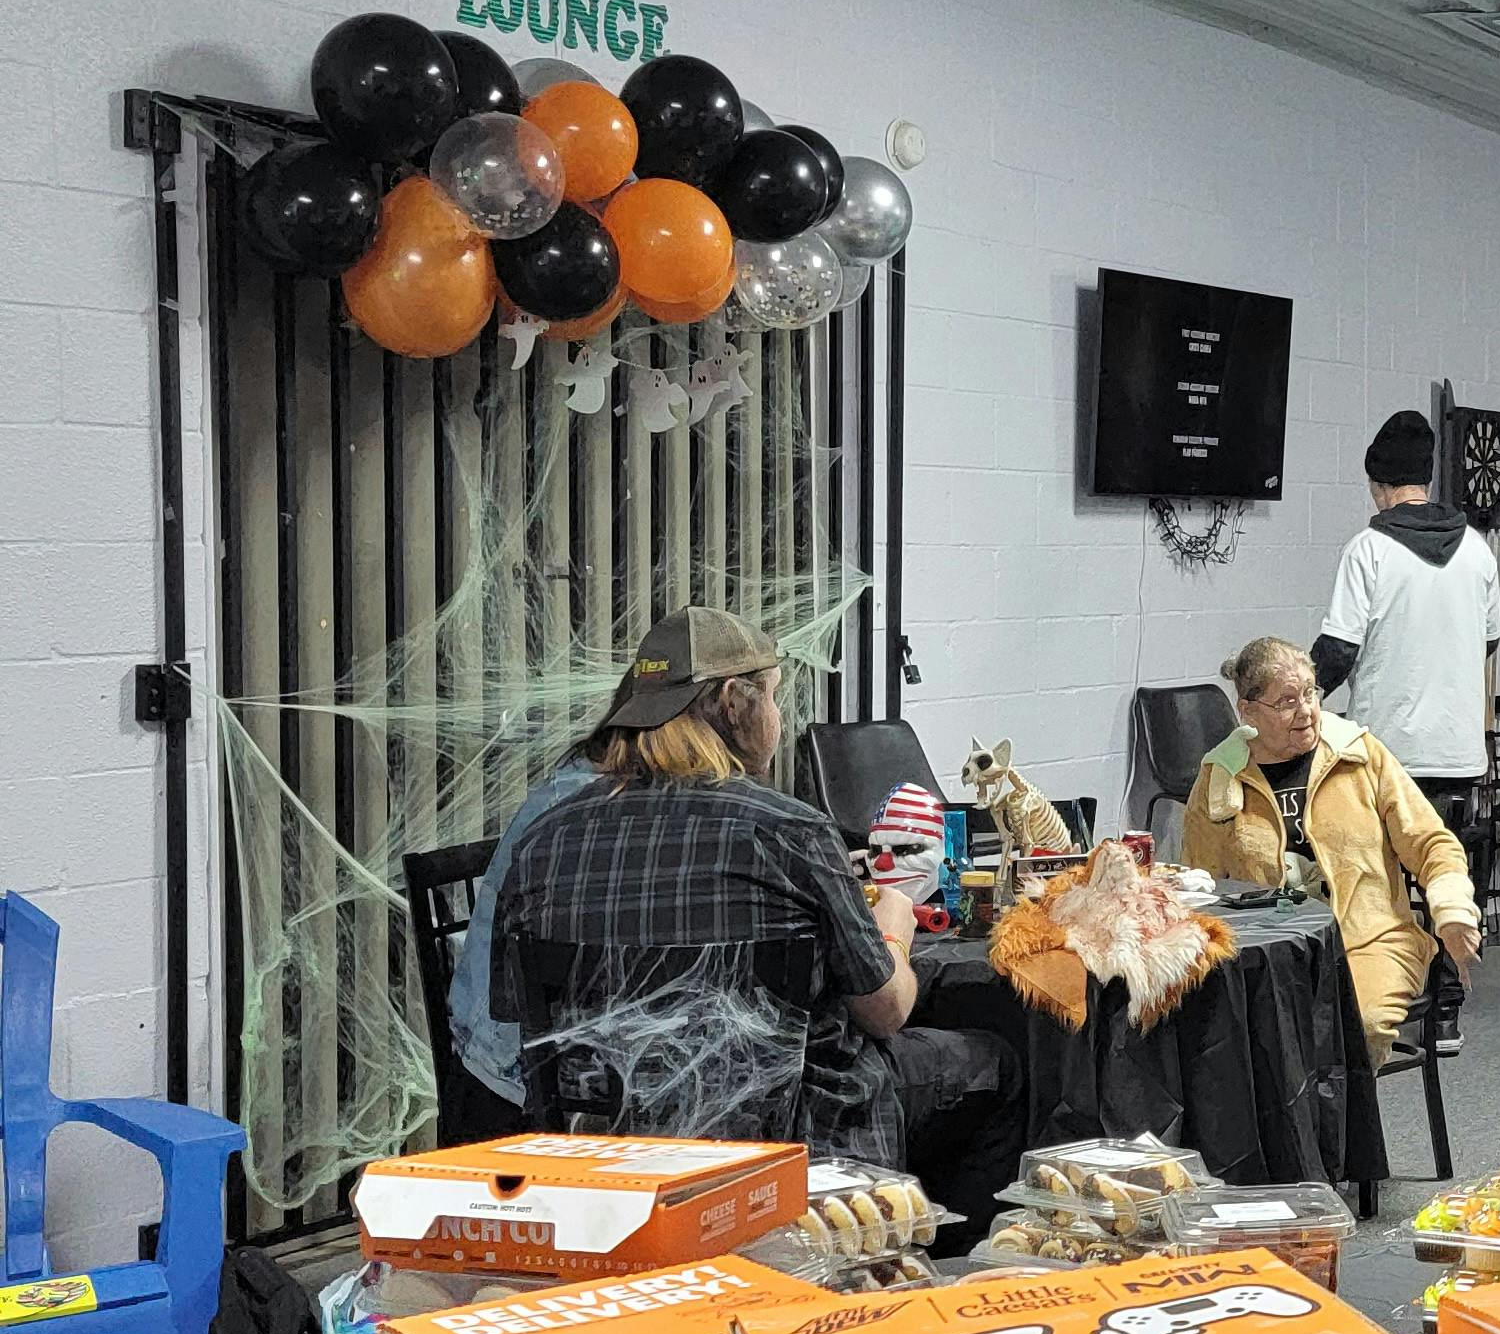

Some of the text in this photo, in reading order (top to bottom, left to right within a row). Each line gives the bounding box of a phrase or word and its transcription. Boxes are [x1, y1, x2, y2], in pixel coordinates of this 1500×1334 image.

[1295, 819, 1306, 844] S
[748, 1180, 778, 1203] SAUCE
[701, 1198, 736, 1226] CHEESE
[431, 1265, 728, 1330] DELIVERY!
[956, 1291, 1098, 1319] Caesars
[976, 1283, 1073, 1306] Little
